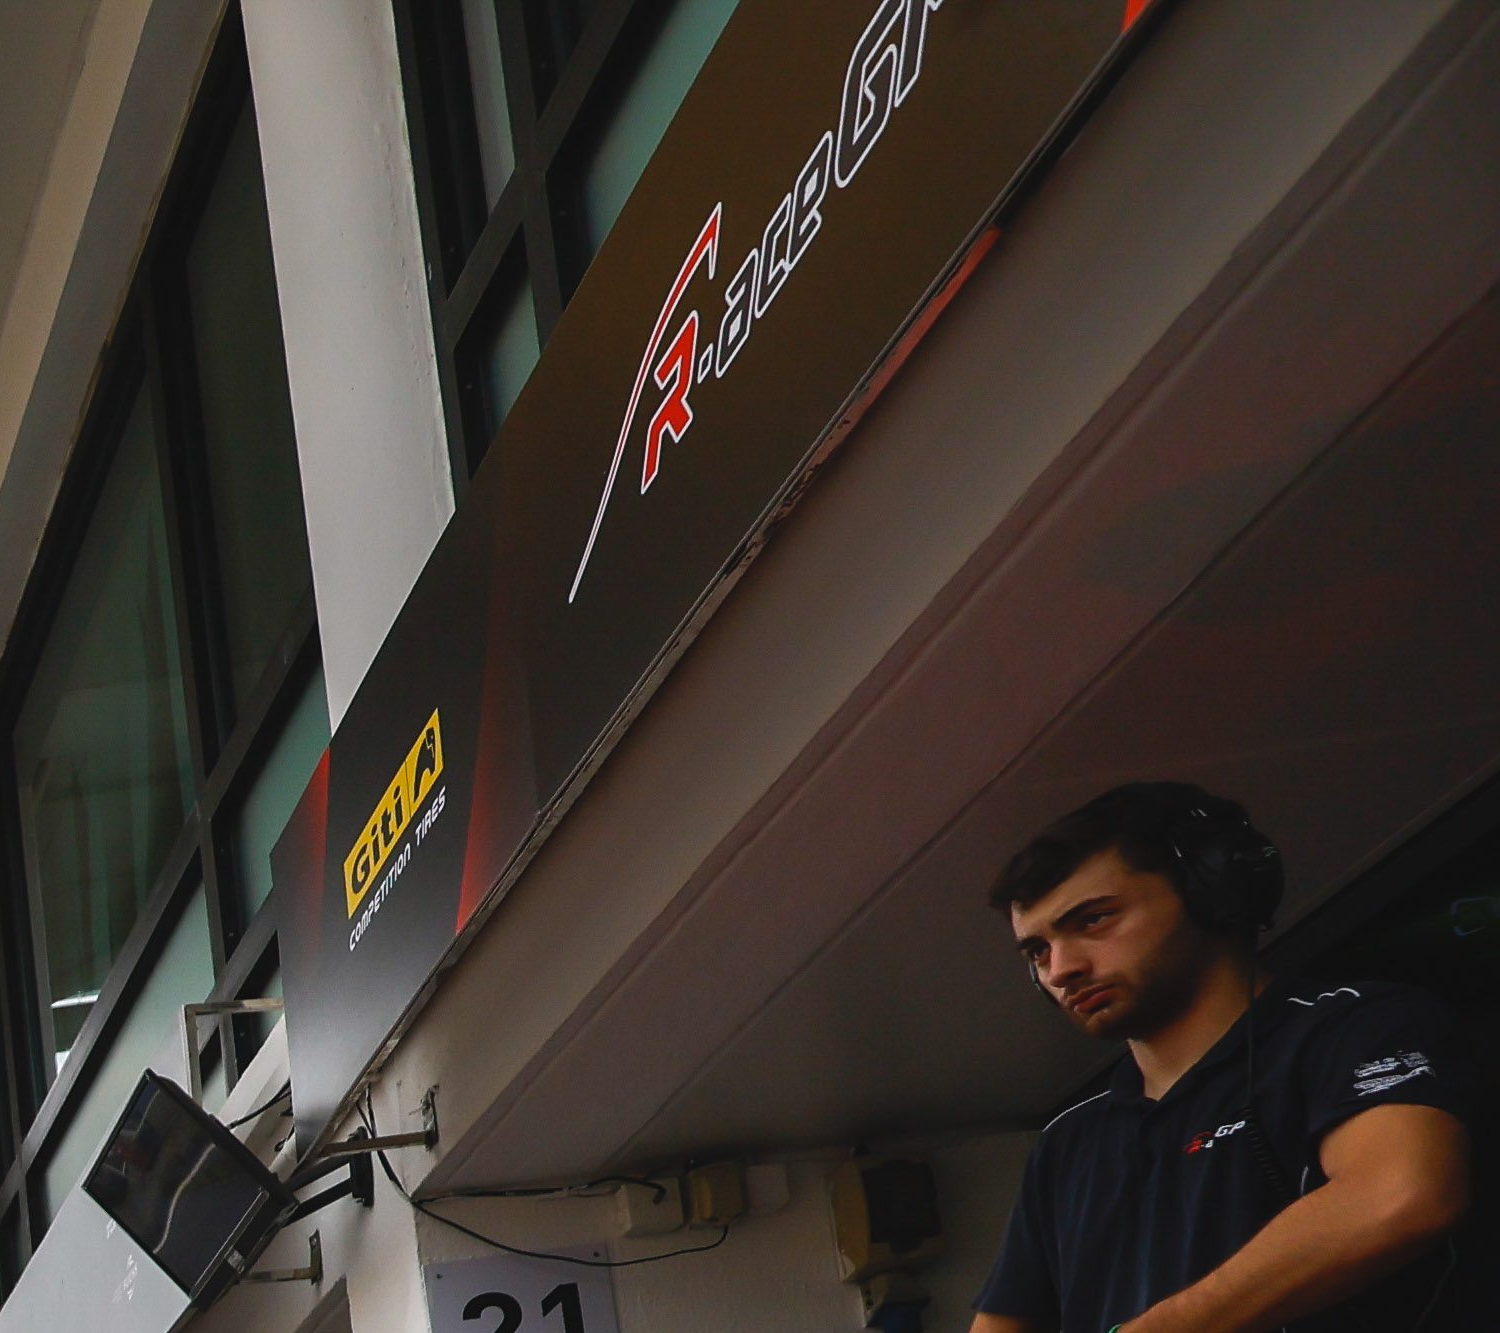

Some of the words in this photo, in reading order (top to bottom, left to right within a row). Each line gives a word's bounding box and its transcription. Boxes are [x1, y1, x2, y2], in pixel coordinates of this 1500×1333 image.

[349, 843, 411, 952] COMPETITION
[415, 785, 447, 847] TIRES
[351, 785, 404, 895] Giti
